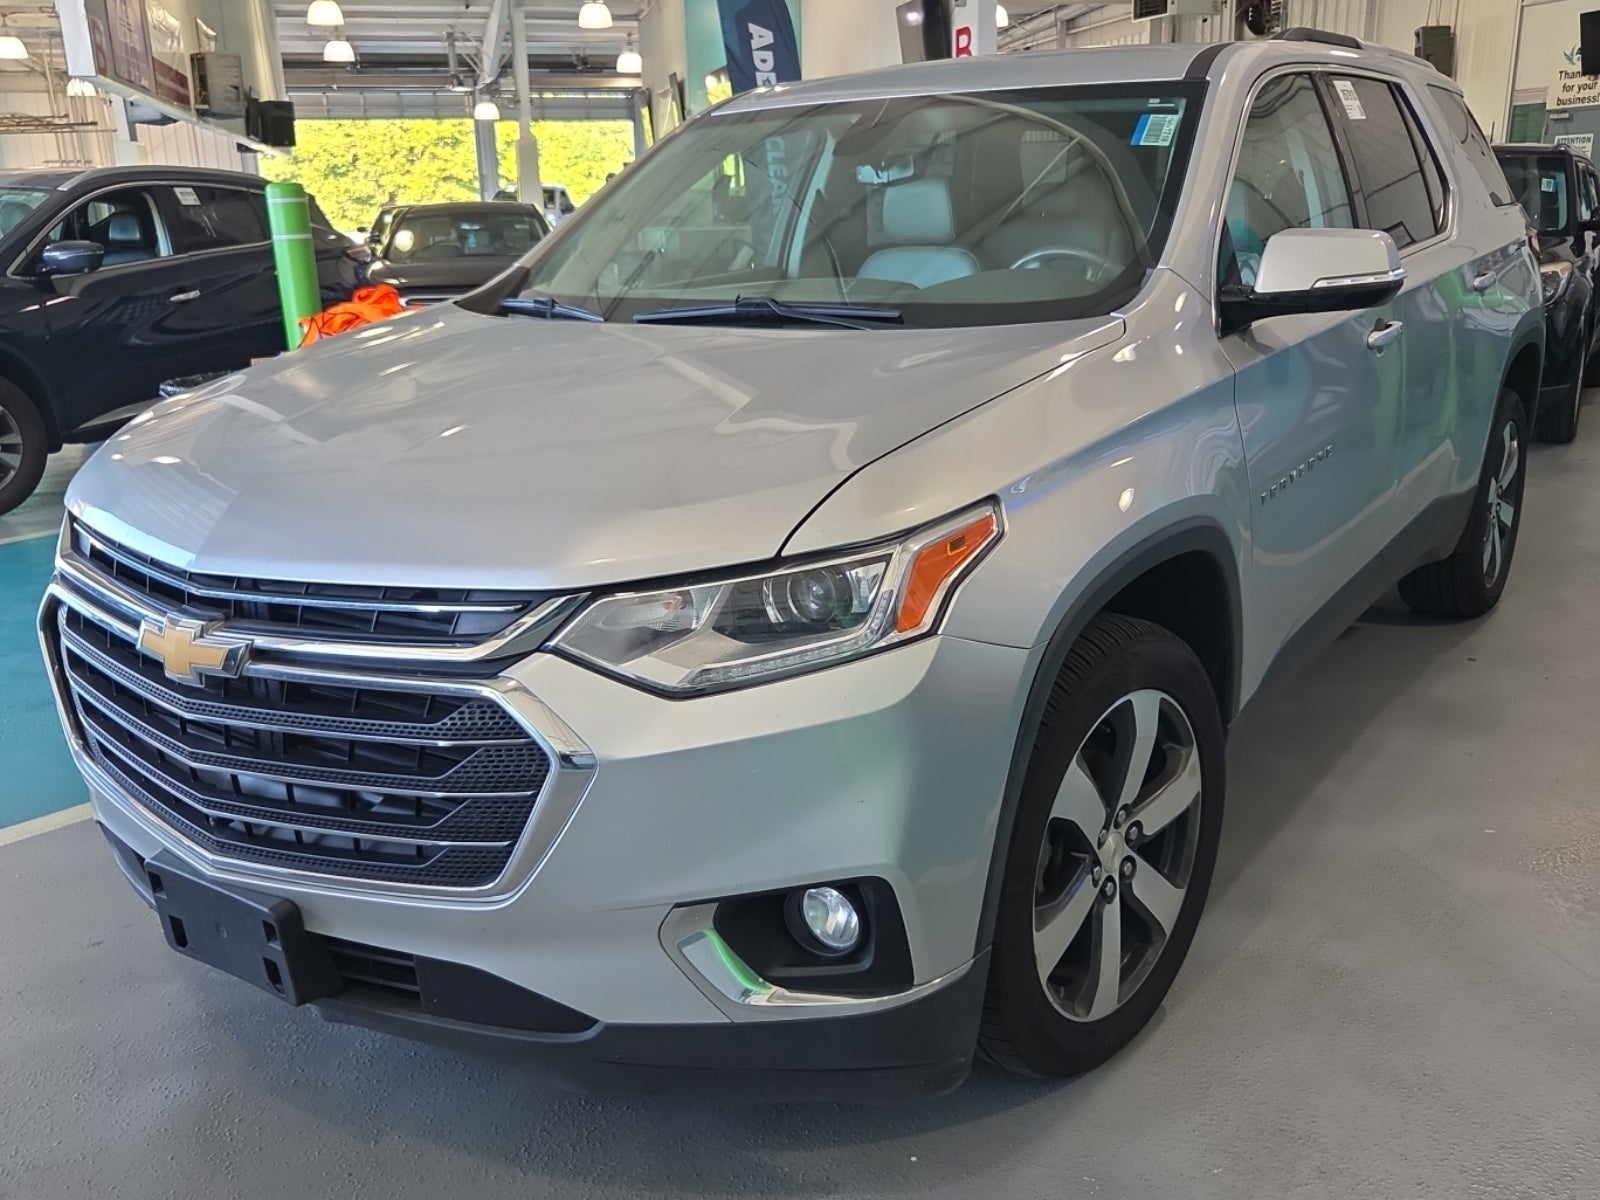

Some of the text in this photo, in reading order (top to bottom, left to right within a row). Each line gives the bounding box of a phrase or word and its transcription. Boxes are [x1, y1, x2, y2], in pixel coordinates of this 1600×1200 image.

[1558, 69, 1586, 80] Than
[1562, 81, 1598, 94] for your
